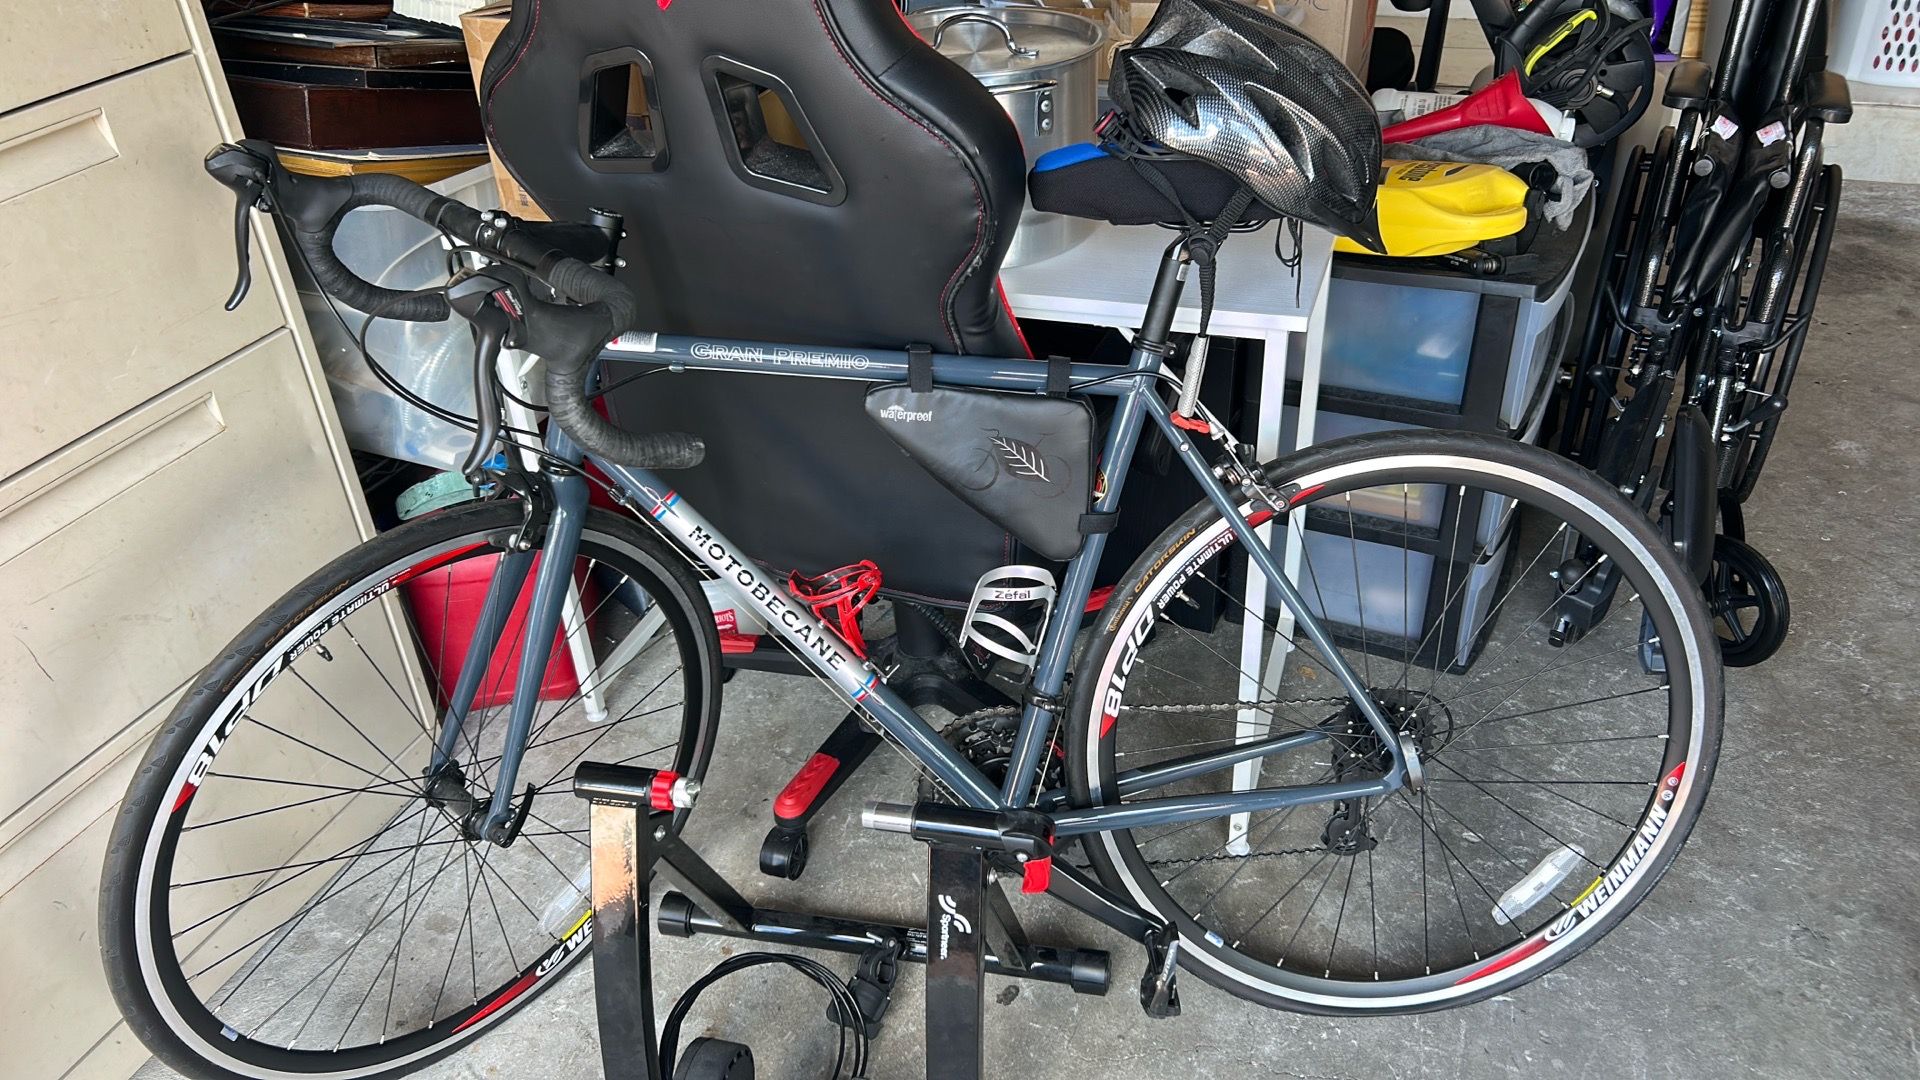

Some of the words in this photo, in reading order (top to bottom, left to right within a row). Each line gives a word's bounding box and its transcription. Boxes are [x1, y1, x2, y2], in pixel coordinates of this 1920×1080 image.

[690, 342, 763, 363] GRAN
[772, 347, 870, 370] PREMIO
[880, 407, 932, 422] waterproof
[1134, 527, 1196, 593] GATORSKIN
[1186, 532, 1235, 577] ULTIMATE
[331, 581, 390, 626] ULTIMATE
[688, 525, 846, 671] MOTOBECANE
[994, 589, 1031, 600] Zéfal
[1156, 575, 1187, 610] POWER
[289, 622, 329, 661] POWER
[1577, 802, 1668, 919] WEINMANN
